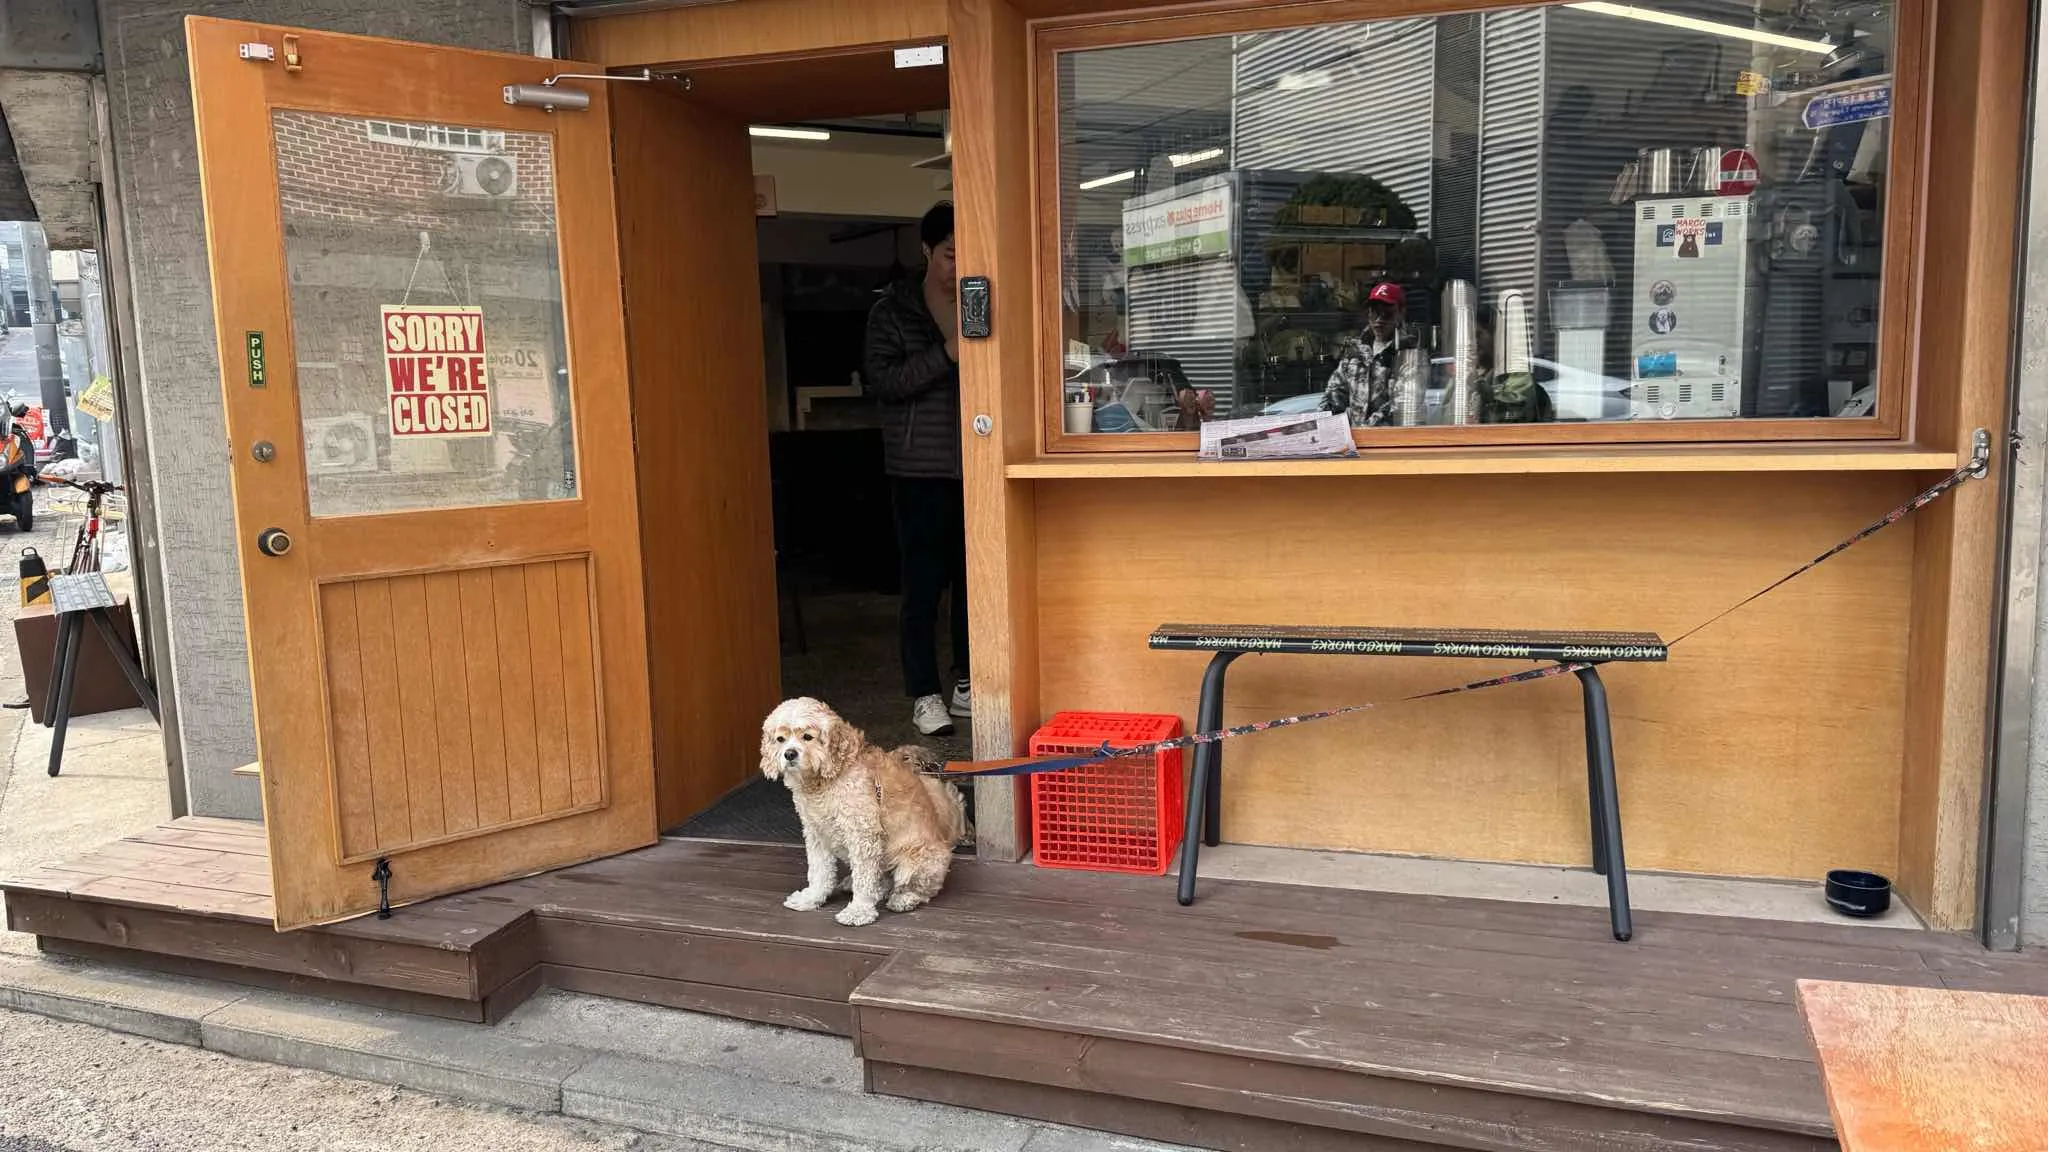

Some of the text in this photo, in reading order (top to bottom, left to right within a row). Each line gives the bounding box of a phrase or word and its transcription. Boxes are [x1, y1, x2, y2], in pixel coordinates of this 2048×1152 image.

[387, 313, 480, 352] SORRY
[250, 336, 263, 382] PUSH
[389, 355, 486, 392] WE'RE
[394, 396, 488, 434] CLOSED
[1195, 635, 1238, 648] WORKS
[1311, 639, 1356, 653] WORKS
[1434, 643, 1480, 656] WORKS
[1562, 645, 1612, 659] WORKS
